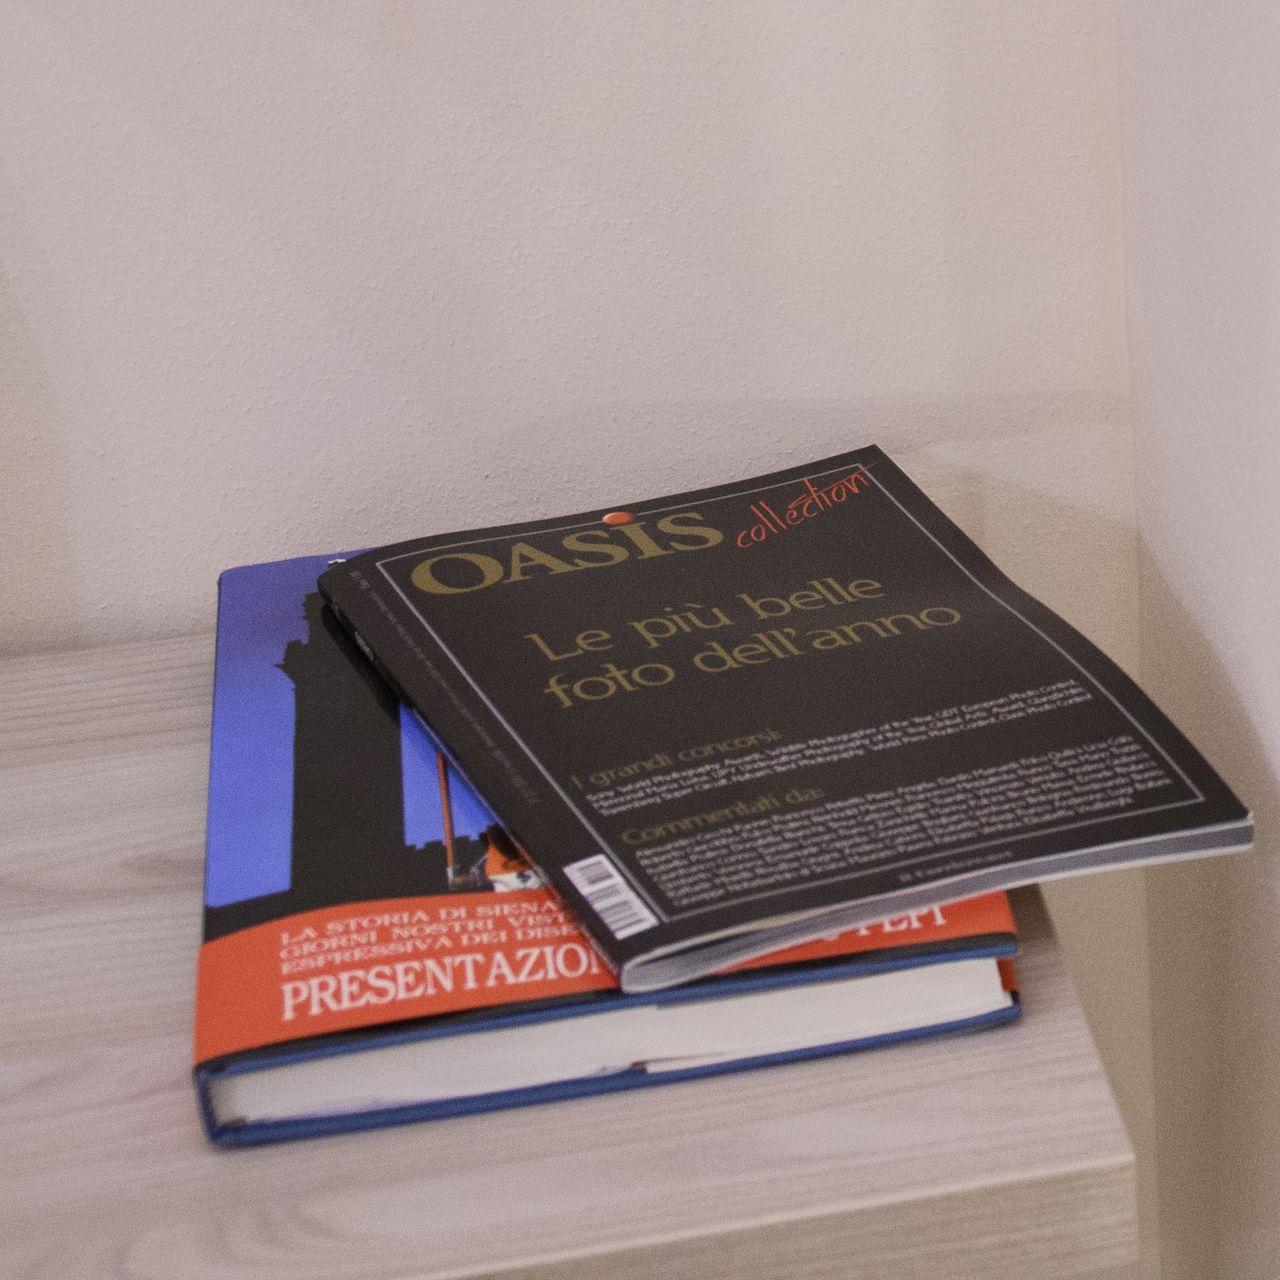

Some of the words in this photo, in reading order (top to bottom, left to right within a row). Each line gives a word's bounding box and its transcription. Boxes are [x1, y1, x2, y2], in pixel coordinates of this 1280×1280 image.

[736, 462, 877, 549] collection
[410, 511, 725, 595] OASIS
[524, 627, 614, 663] Le
[628, 602, 733, 649] più
[736, 576, 887, 621] belle
[544, 661, 676, 709] foto
[693, 606, 962, 673] dell'anno
[589, 752, 673, 787] grandi
[621, 795, 780, 844] Commentati
[279, 931, 378, 962] GIORNI
[390, 917, 494, 945] NOSTRI
[280, 924, 314, 946] LA
[324, 908, 431, 936] STORIA
[438, 906, 470, 921] DI
[281, 936, 453, 976] ESPRESSIVA
